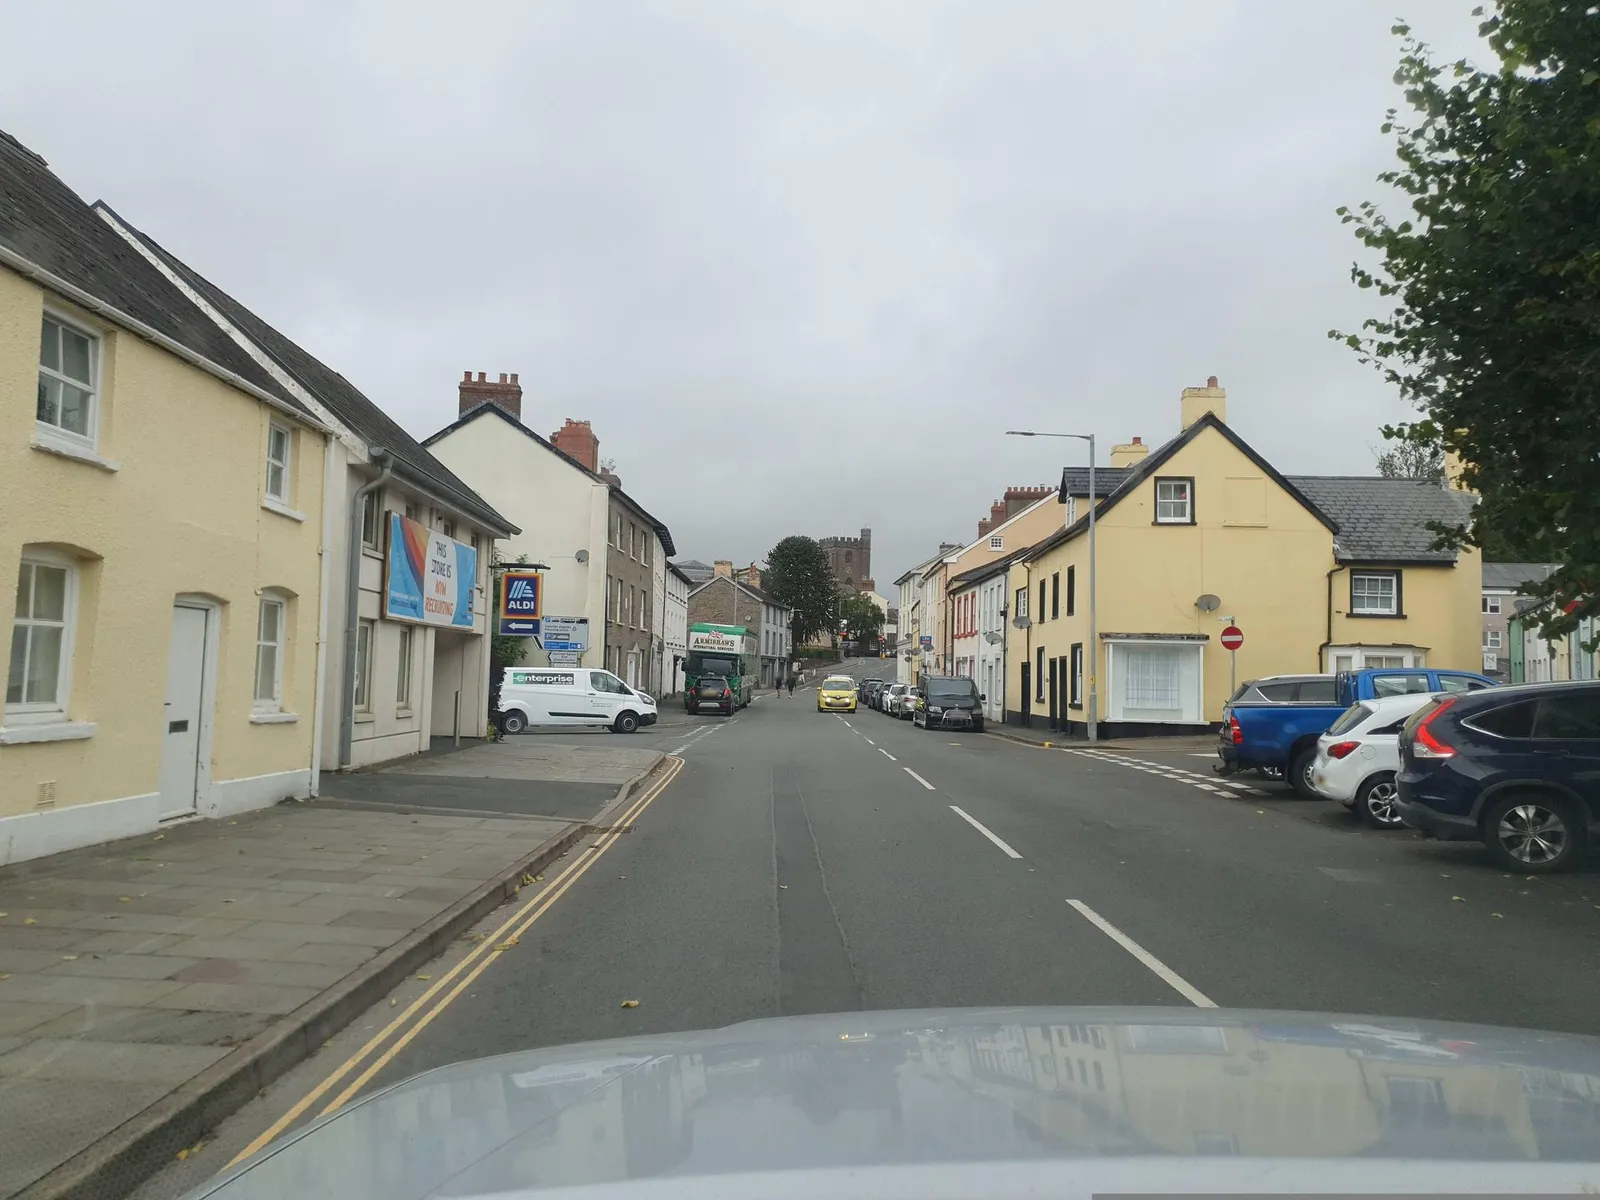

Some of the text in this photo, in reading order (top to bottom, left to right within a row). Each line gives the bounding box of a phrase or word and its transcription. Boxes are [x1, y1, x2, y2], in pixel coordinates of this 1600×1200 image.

[436, 541, 446, 558] THIS
[431, 559, 452, 578] STORE IS
[508, 600, 535, 609] ALDI
[693, 637, 735, 647] ARMISHAWS
[514, 674, 574, 684] enterprise
